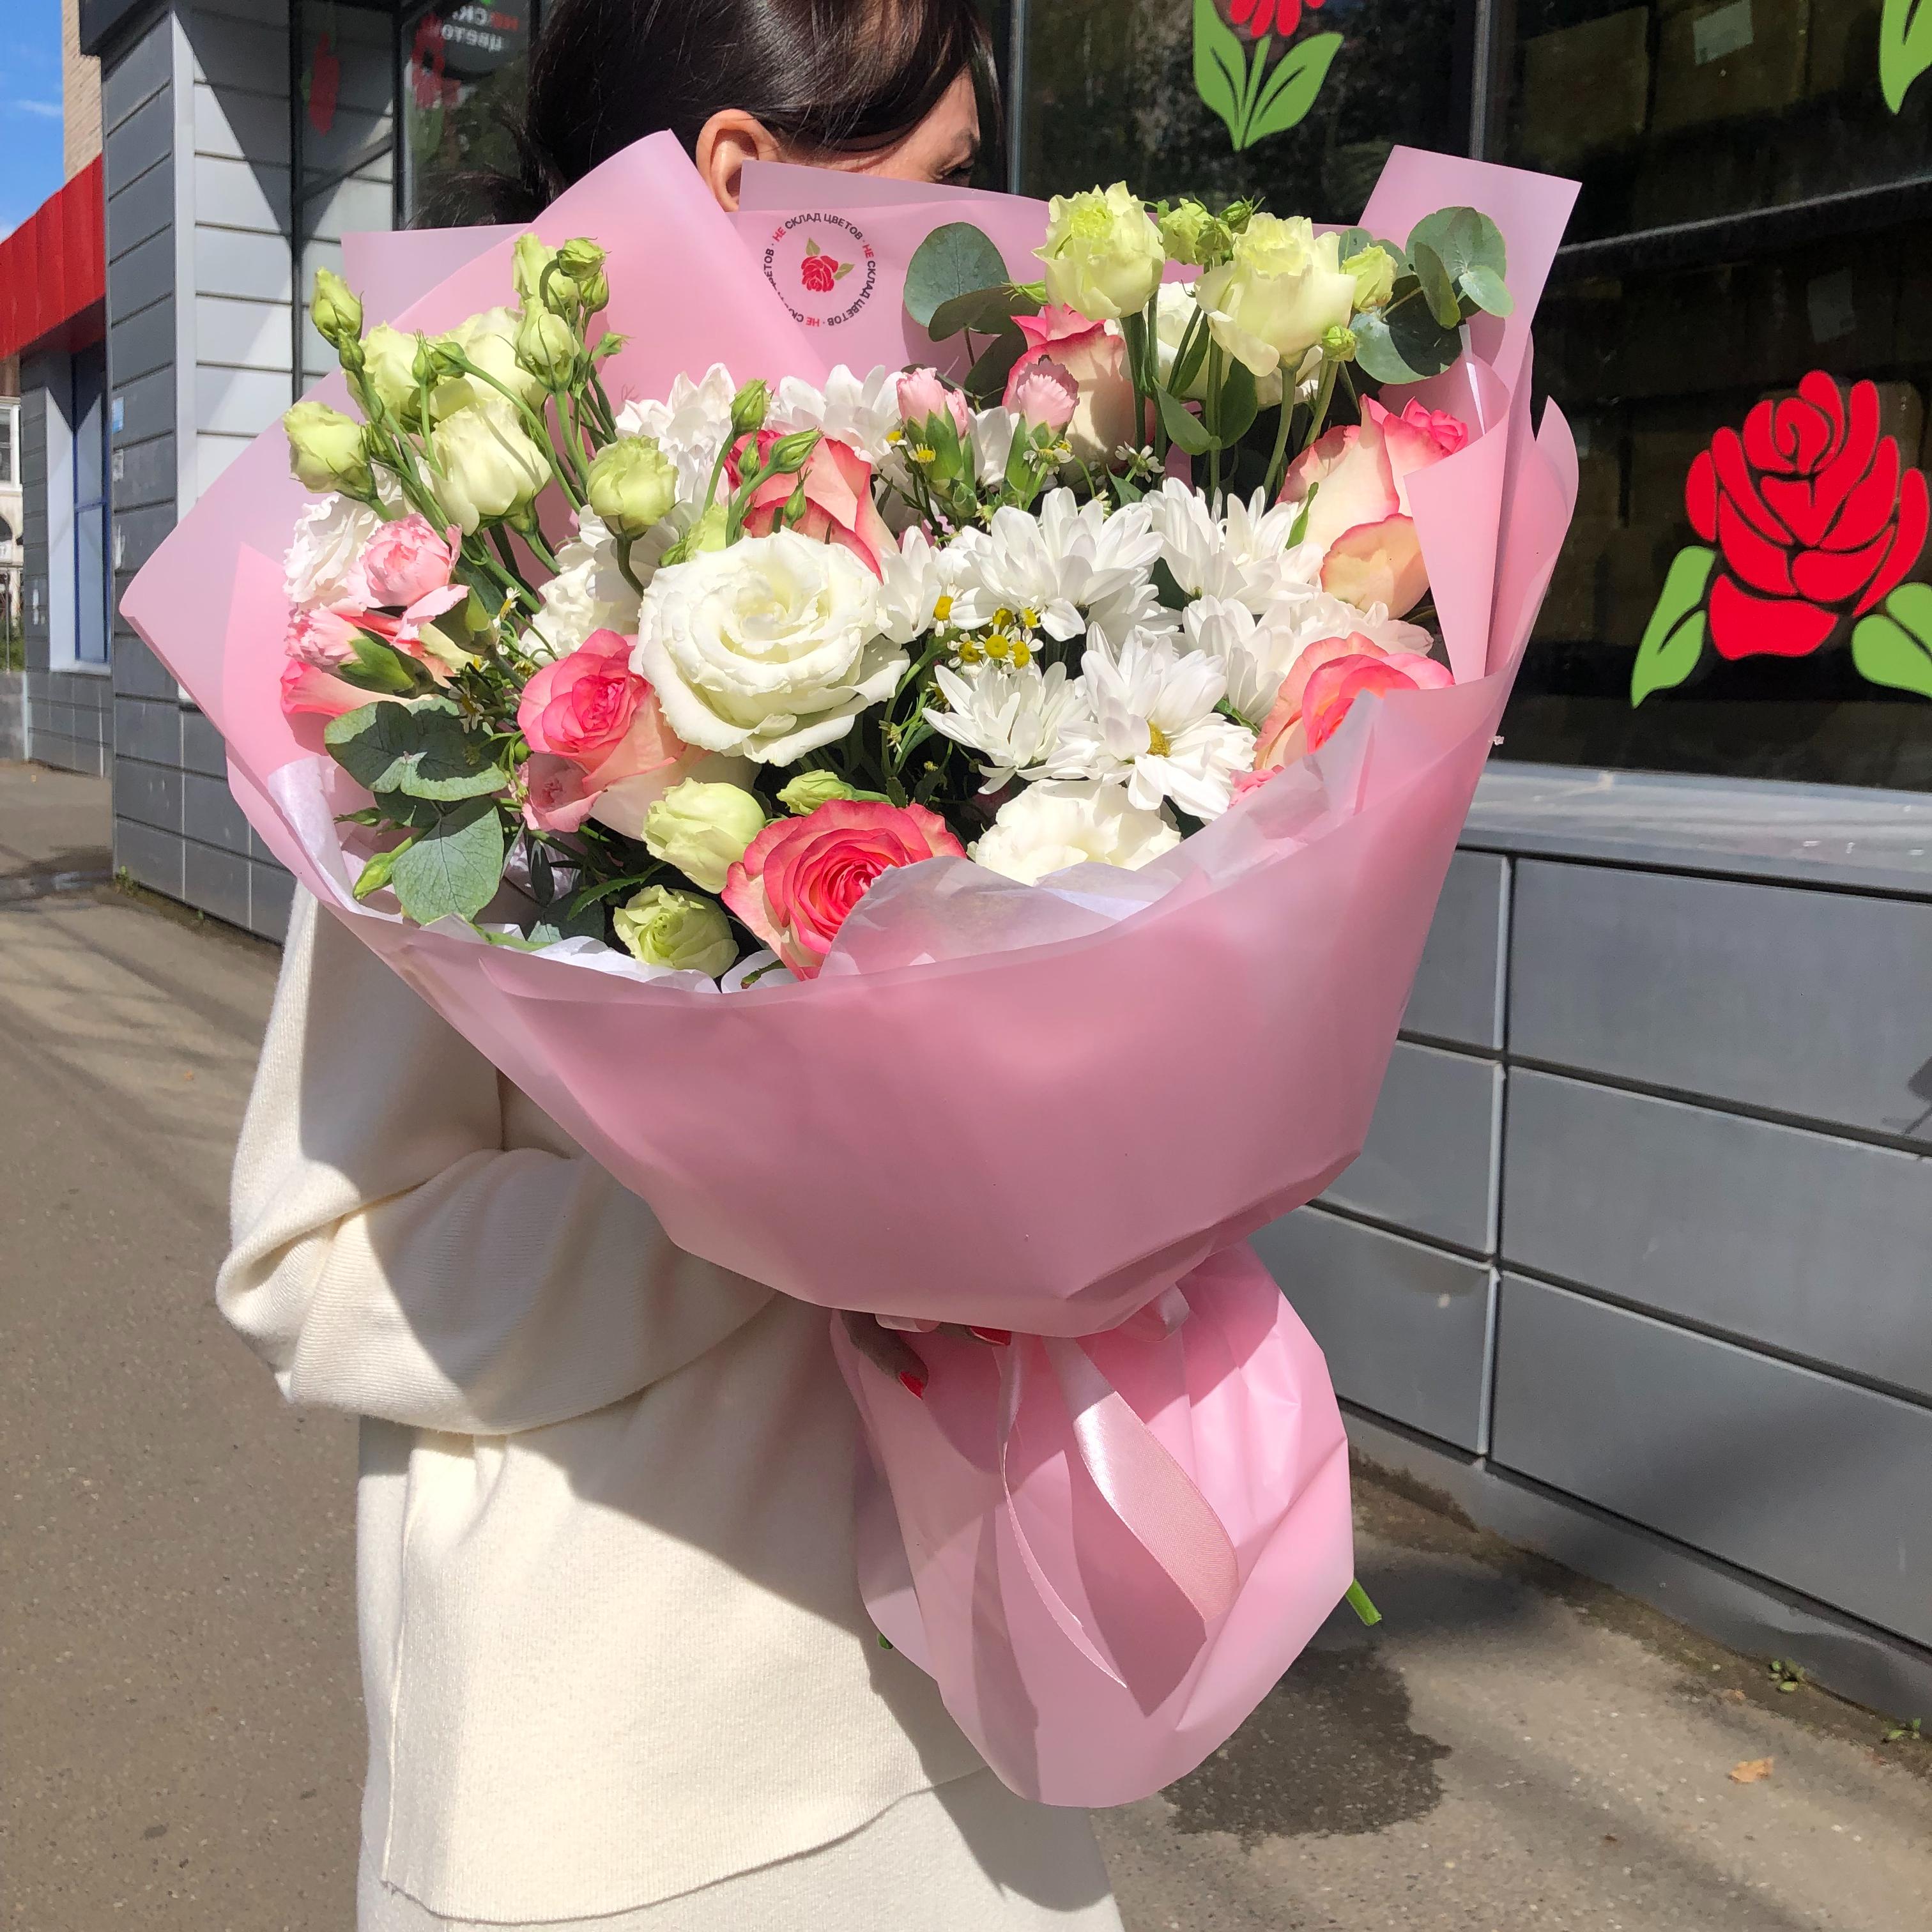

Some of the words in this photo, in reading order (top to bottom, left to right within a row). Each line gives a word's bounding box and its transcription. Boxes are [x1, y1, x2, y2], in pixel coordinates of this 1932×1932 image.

[772, 227, 786, 242] НЕ
[785, 213, 822, 229] СКЛАД
[824, 213, 863, 240] ЦВЕТОВ
[862, 243, 875, 259] НЕ
[763, 248, 777, 291] ЕТОВ
[859, 260, 876, 299] СКЛАД
[806, 317, 820, 327] НЕ
[827, 298, 866, 326] ЦВЕТОВ
